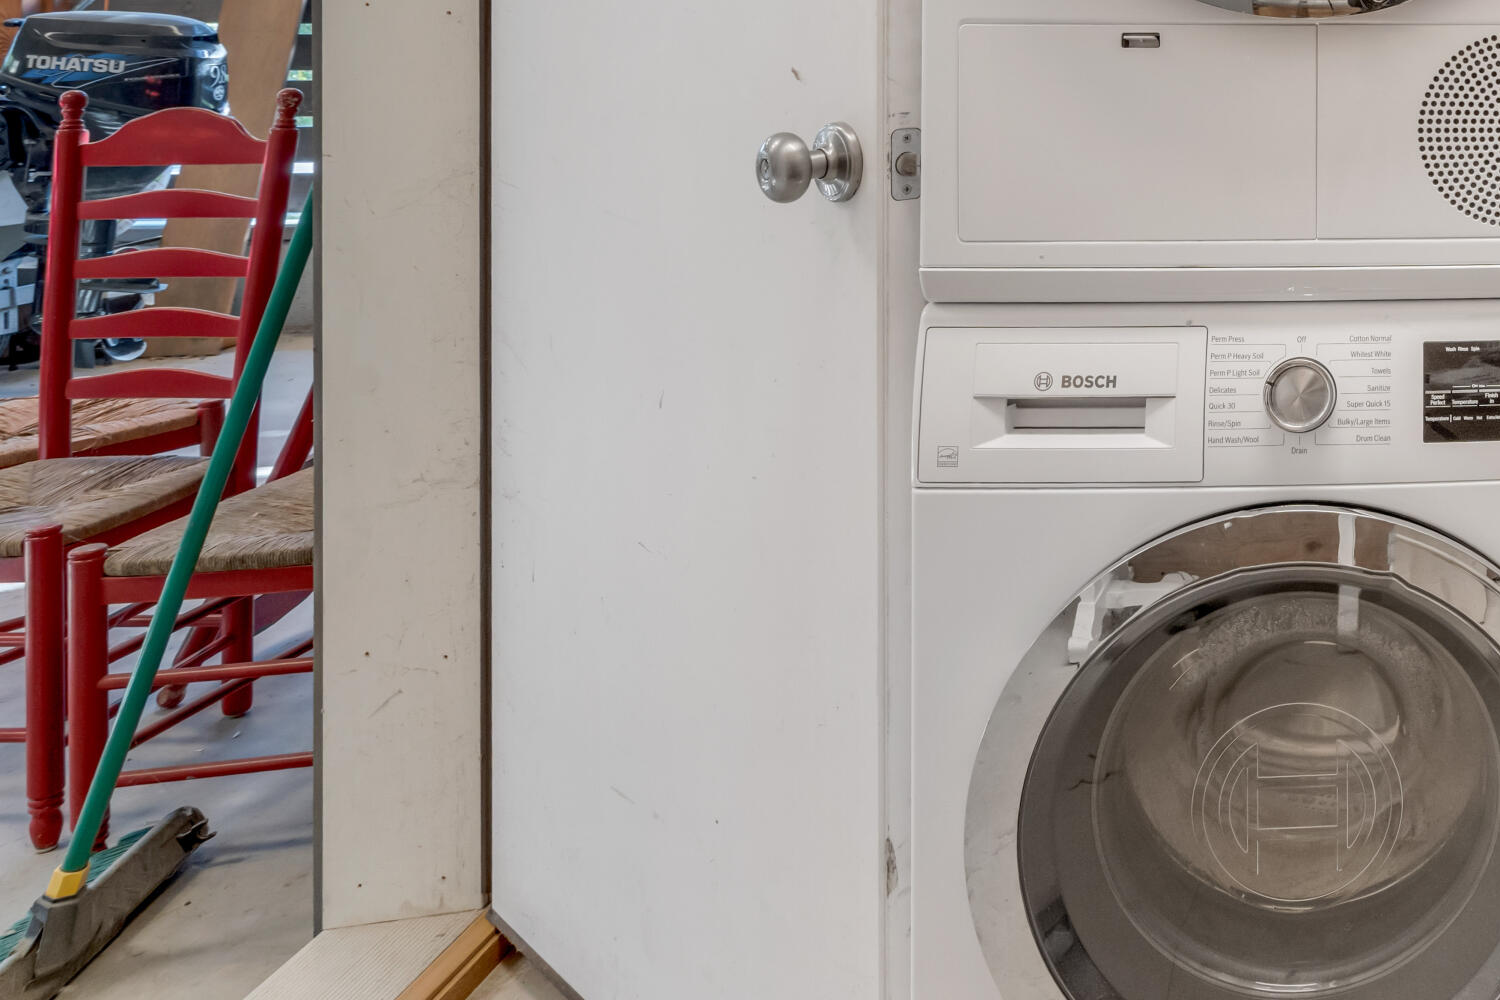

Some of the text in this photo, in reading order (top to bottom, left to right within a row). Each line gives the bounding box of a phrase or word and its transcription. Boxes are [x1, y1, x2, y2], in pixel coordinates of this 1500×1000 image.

[26, 54, 126, 74] TOHATSU
[1211, 335, 1227, 343] Perm
[1232, 370, 1247, 378] Light
[1061, 375, 1117, 389] BOSCH
[1209, 386, 1236, 394] Delicates
[1367, 384, 1391, 392] Sanitize
[1347, 400, 1364, 409] Super
[1208, 420, 1241, 428] Rinse/Spin
[1337, 418, 1373, 426] Bulky/Large
[1225, 436, 1259, 444] Wash/Wool
[1355, 434, 1391, 442] Drum Clean
[1291, 446, 1307, 455] Drain
